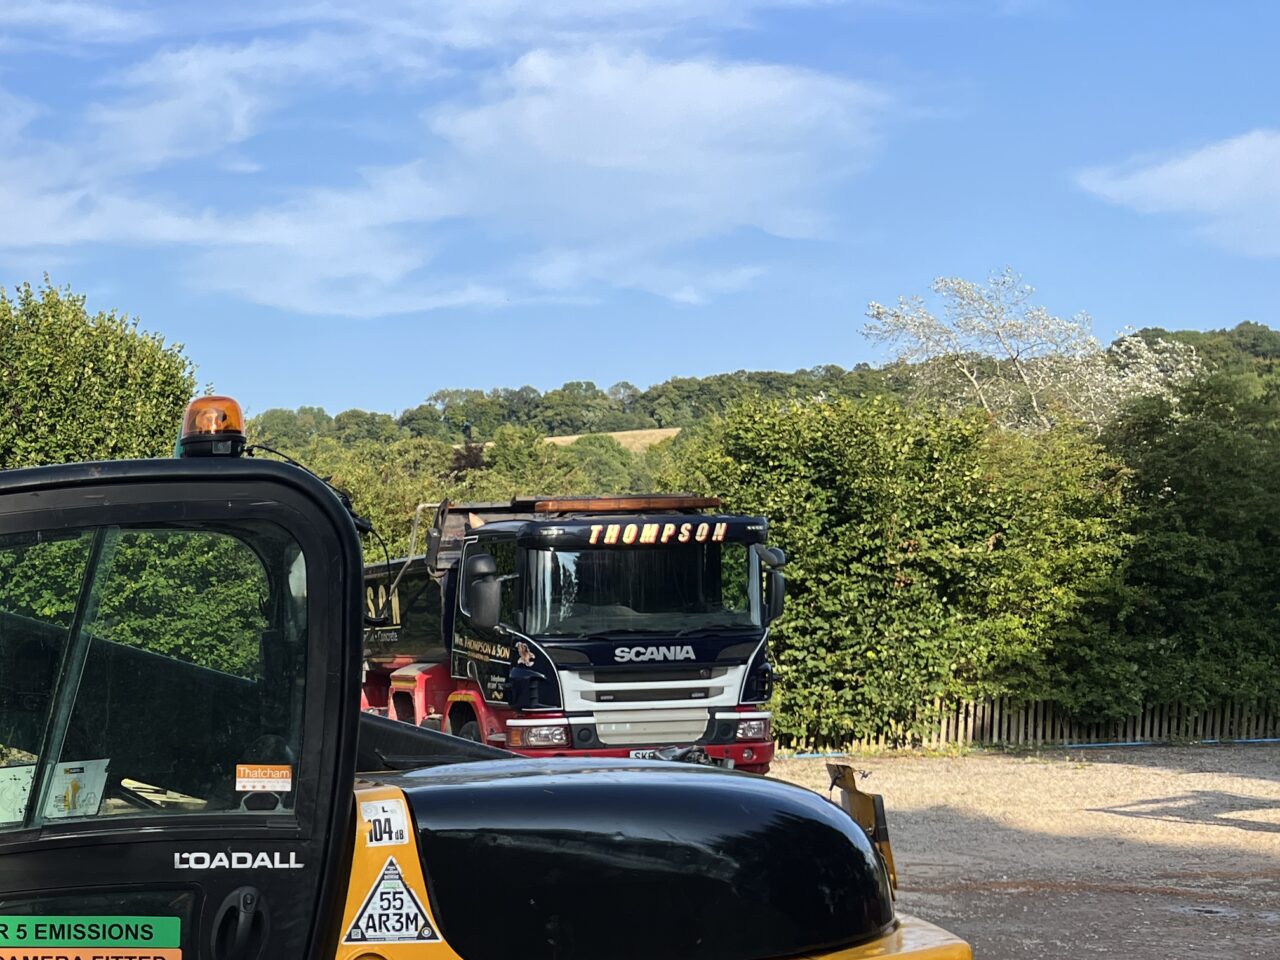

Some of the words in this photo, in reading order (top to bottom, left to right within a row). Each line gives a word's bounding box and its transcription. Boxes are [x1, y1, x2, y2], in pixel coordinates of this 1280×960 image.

[588, 522, 727, 545] THOMPSON
[496, 644, 510, 659] SON
[614, 645, 696, 663] SCANIA
[239, 767, 290, 779] Thatcham
[368, 817, 394, 843] 104
[394, 829, 404, 840] dB
[173, 851, 305, 869] LOADALL
[379, 891, 404, 911] 55
[365, 912, 419, 933] AR3M
[16, 923, 28, 941] 5
[34, 923, 154, 942] EMISSIONS
